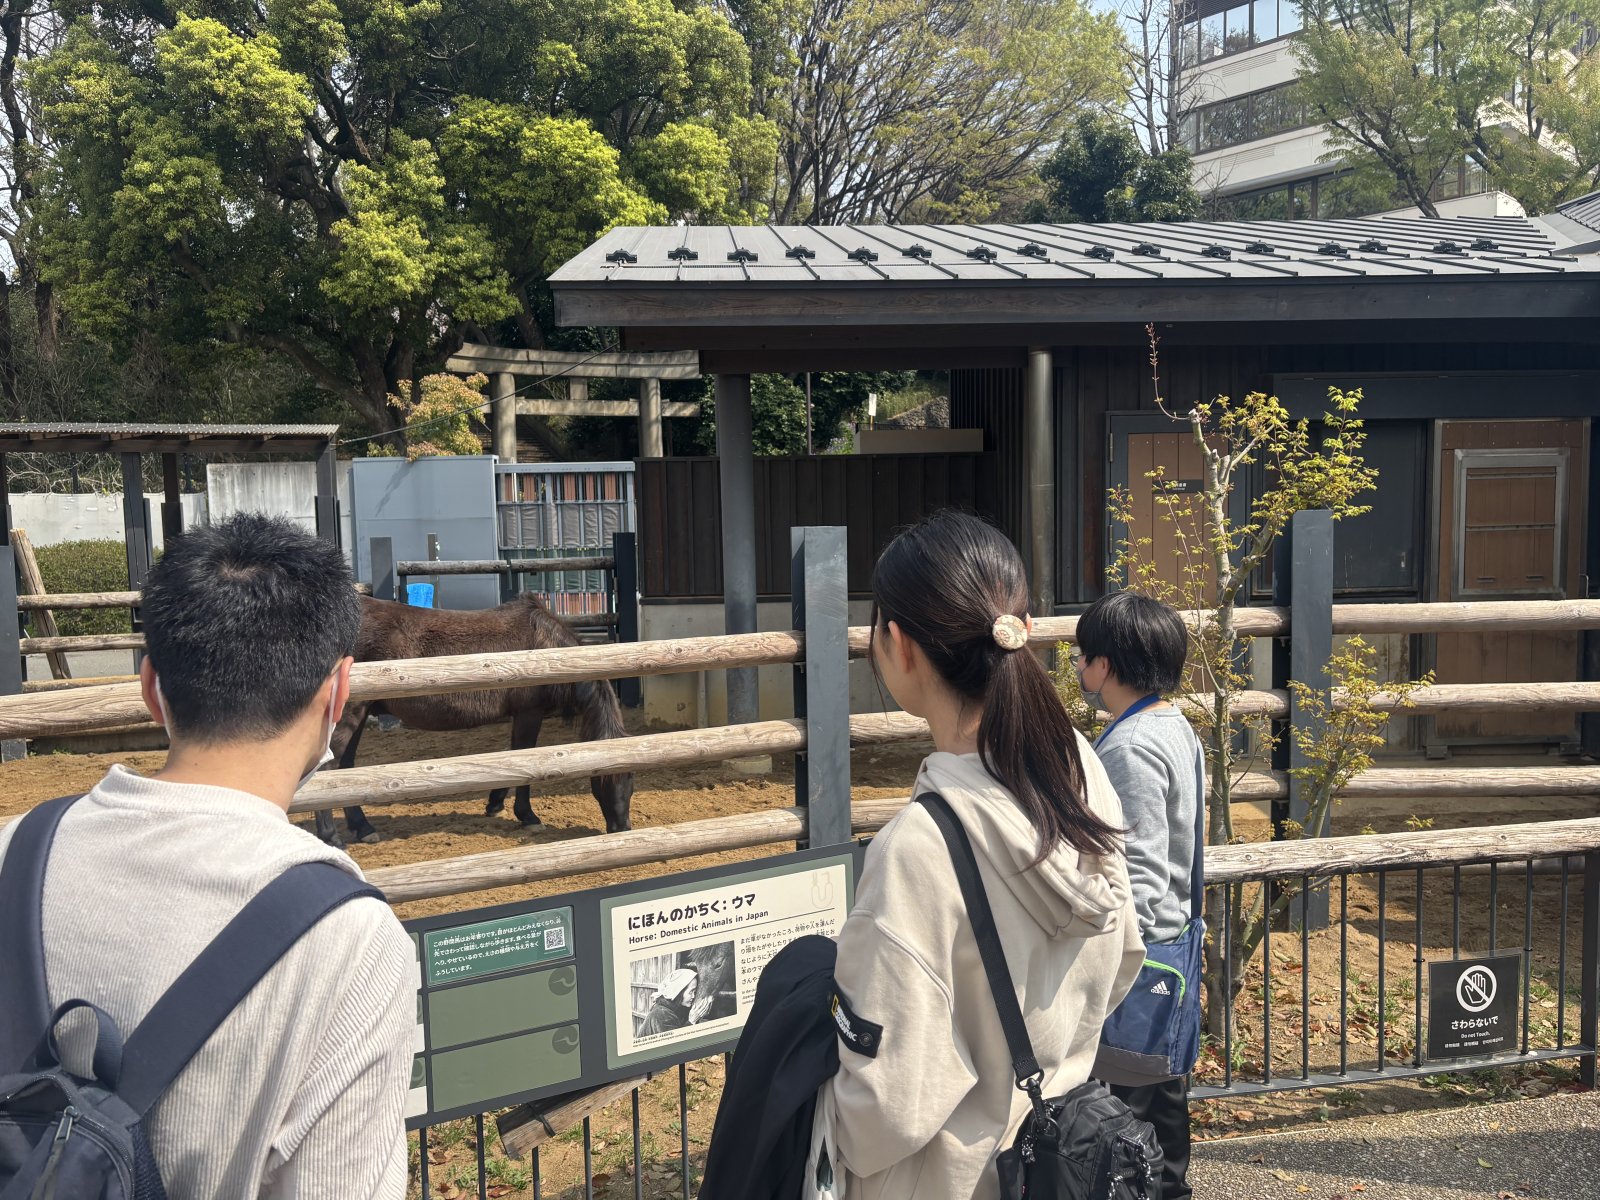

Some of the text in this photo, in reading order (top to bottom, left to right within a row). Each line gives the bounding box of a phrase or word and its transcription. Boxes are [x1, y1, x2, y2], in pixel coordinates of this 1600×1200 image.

[629, 910, 769, 944] Horse: Domestic Animals in Japan
[1150, 988, 1171, 996] adidas
[1450, 1015, 1499, 1031] さわらないで
